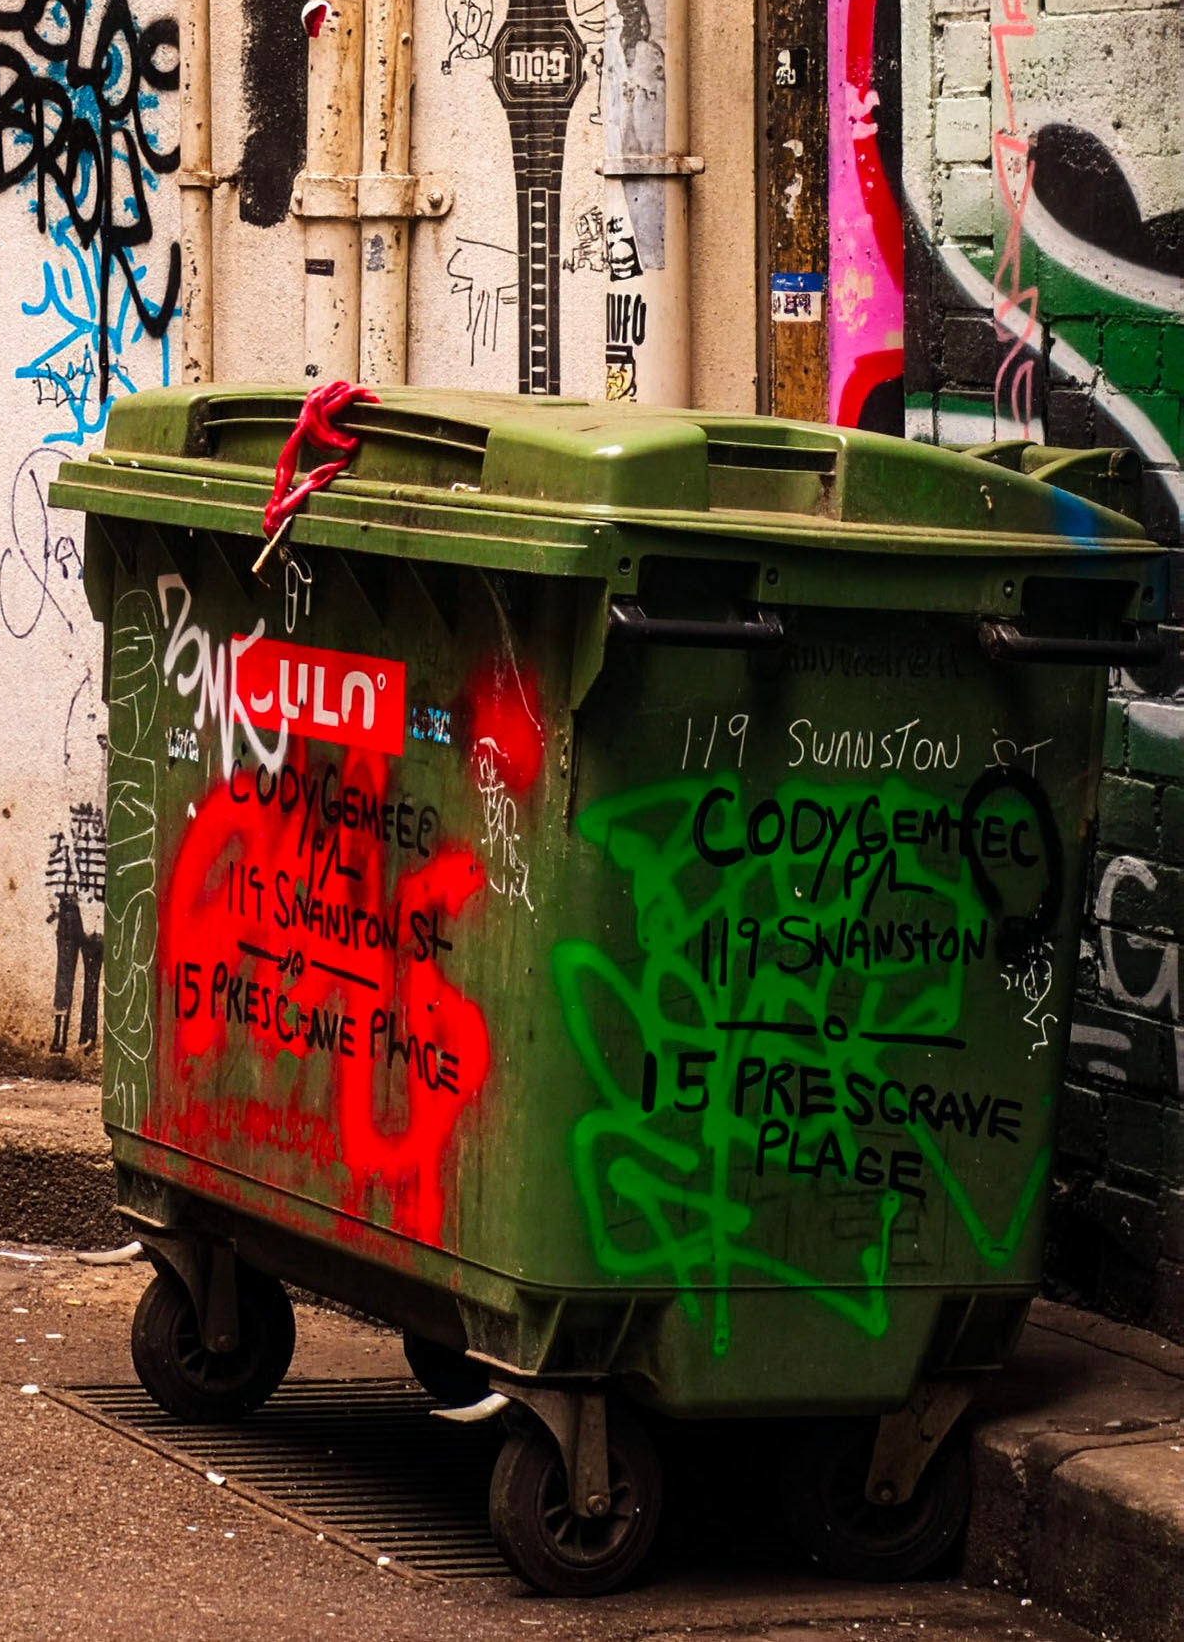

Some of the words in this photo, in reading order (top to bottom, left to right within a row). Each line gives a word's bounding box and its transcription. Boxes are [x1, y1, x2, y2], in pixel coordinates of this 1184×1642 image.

[682, 714, 750, 770] 119
[789, 718, 960, 770] SWANSTON
[700, 917, 761, 986] 119
[641, 1050, 717, 1113] 15
[733, 1056, 1024, 1144] PRESGRAVE
